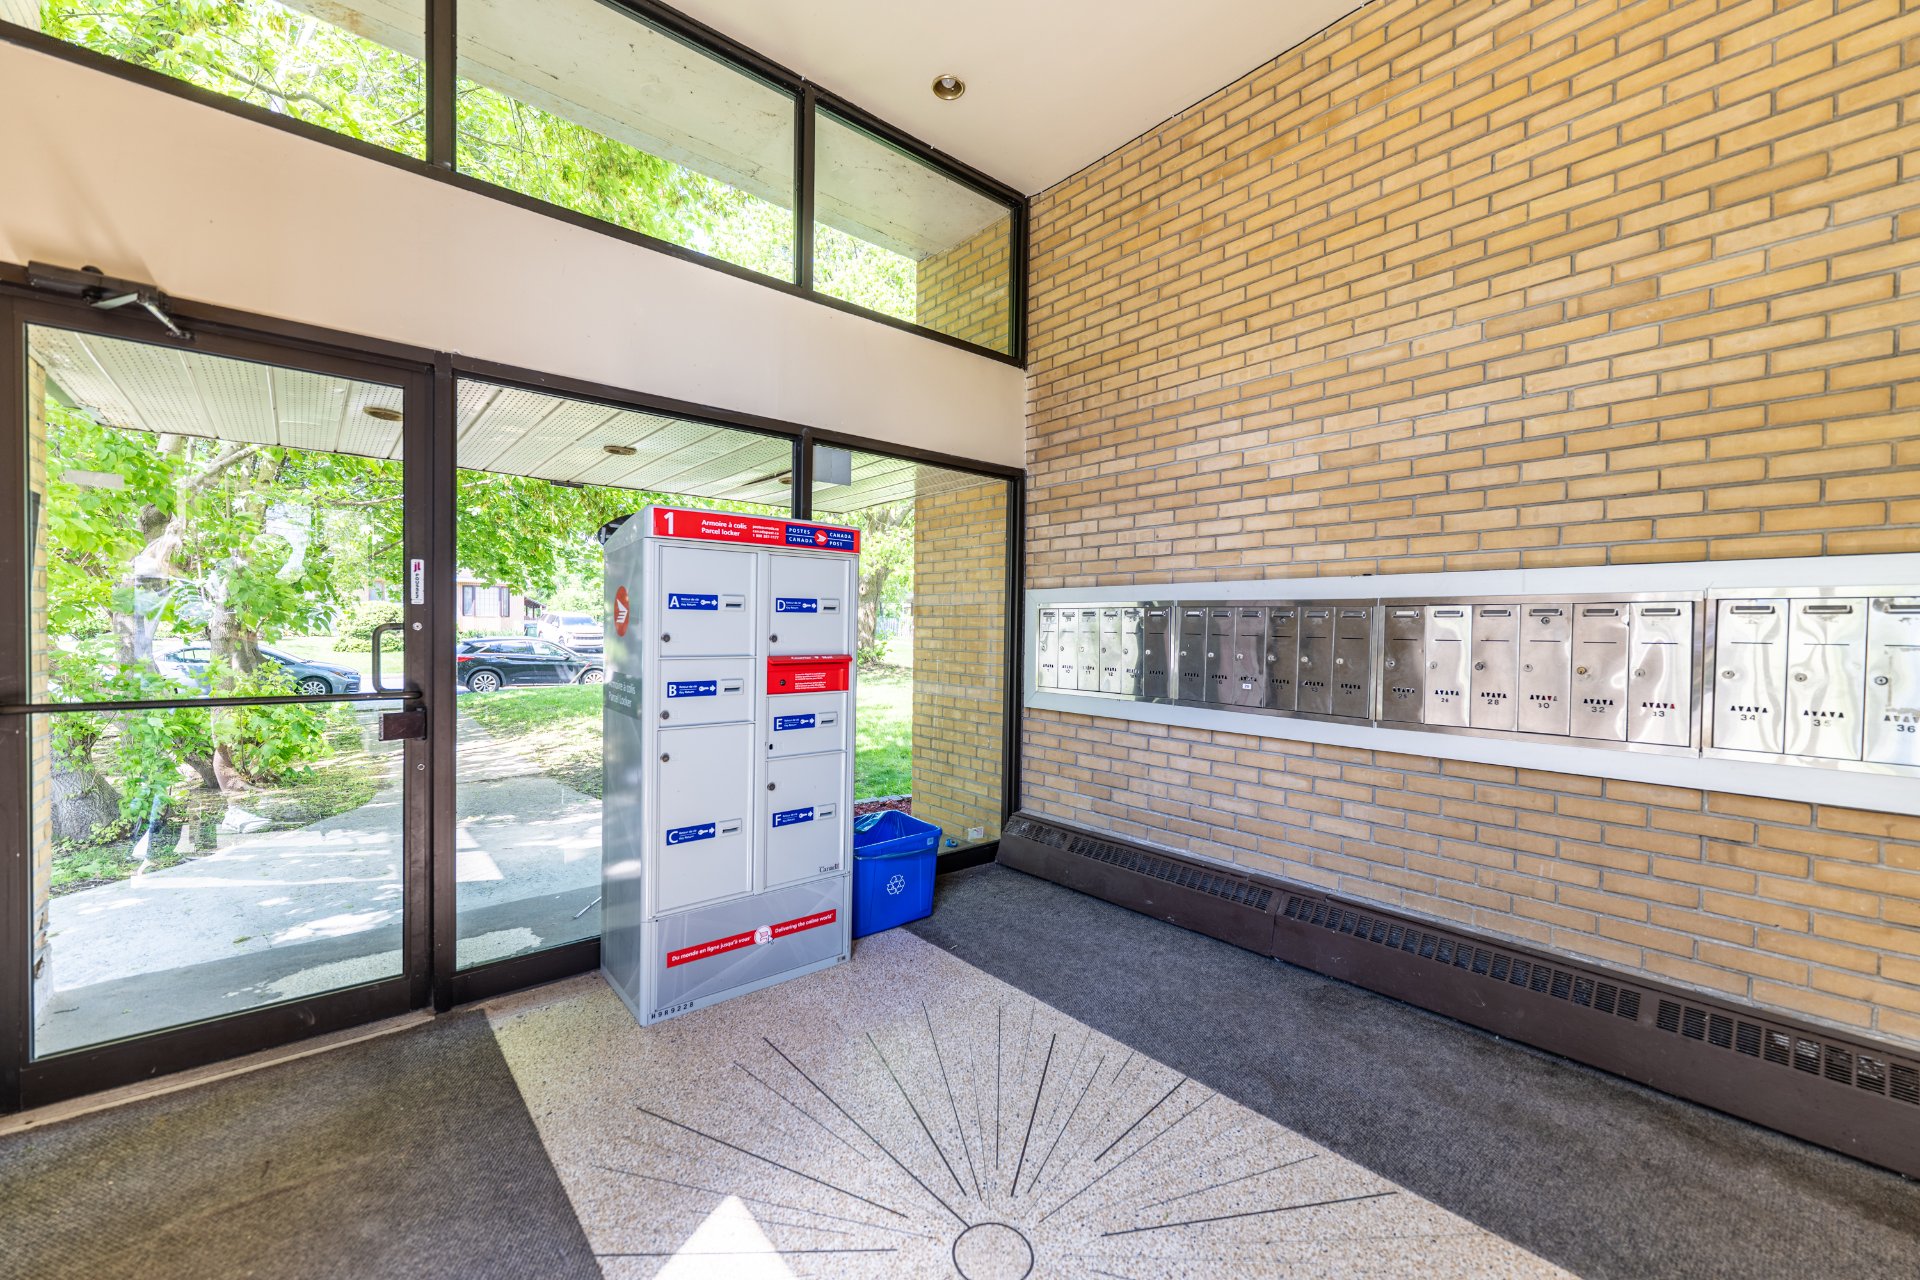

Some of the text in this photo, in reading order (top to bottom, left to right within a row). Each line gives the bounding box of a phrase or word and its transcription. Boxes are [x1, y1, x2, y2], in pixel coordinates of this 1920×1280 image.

[663, 511, 674, 535] 1
[701, 519, 727, 528] Armoire
[733, 522, 747, 530] colis
[701, 527, 741, 537] Parcel locker
[788, 527, 811, 535] POSTES
[788, 536, 813, 544] CANADA
[669, 595, 680, 608] A
[777, 600, 786, 611] D
[668, 684, 677, 696] B
[776, 718, 783, 730] E
[1896, 724, 1916, 733] 36
[775, 814, 782, 826] F
[668, 830, 678, 843] C
[774, 922, 798, 934] Delivering
[805, 918, 819, 926] online
[819, 914, 832, 922] world
[680, 950, 699, 959] monde
[706, 944, 720, 953] ligne
